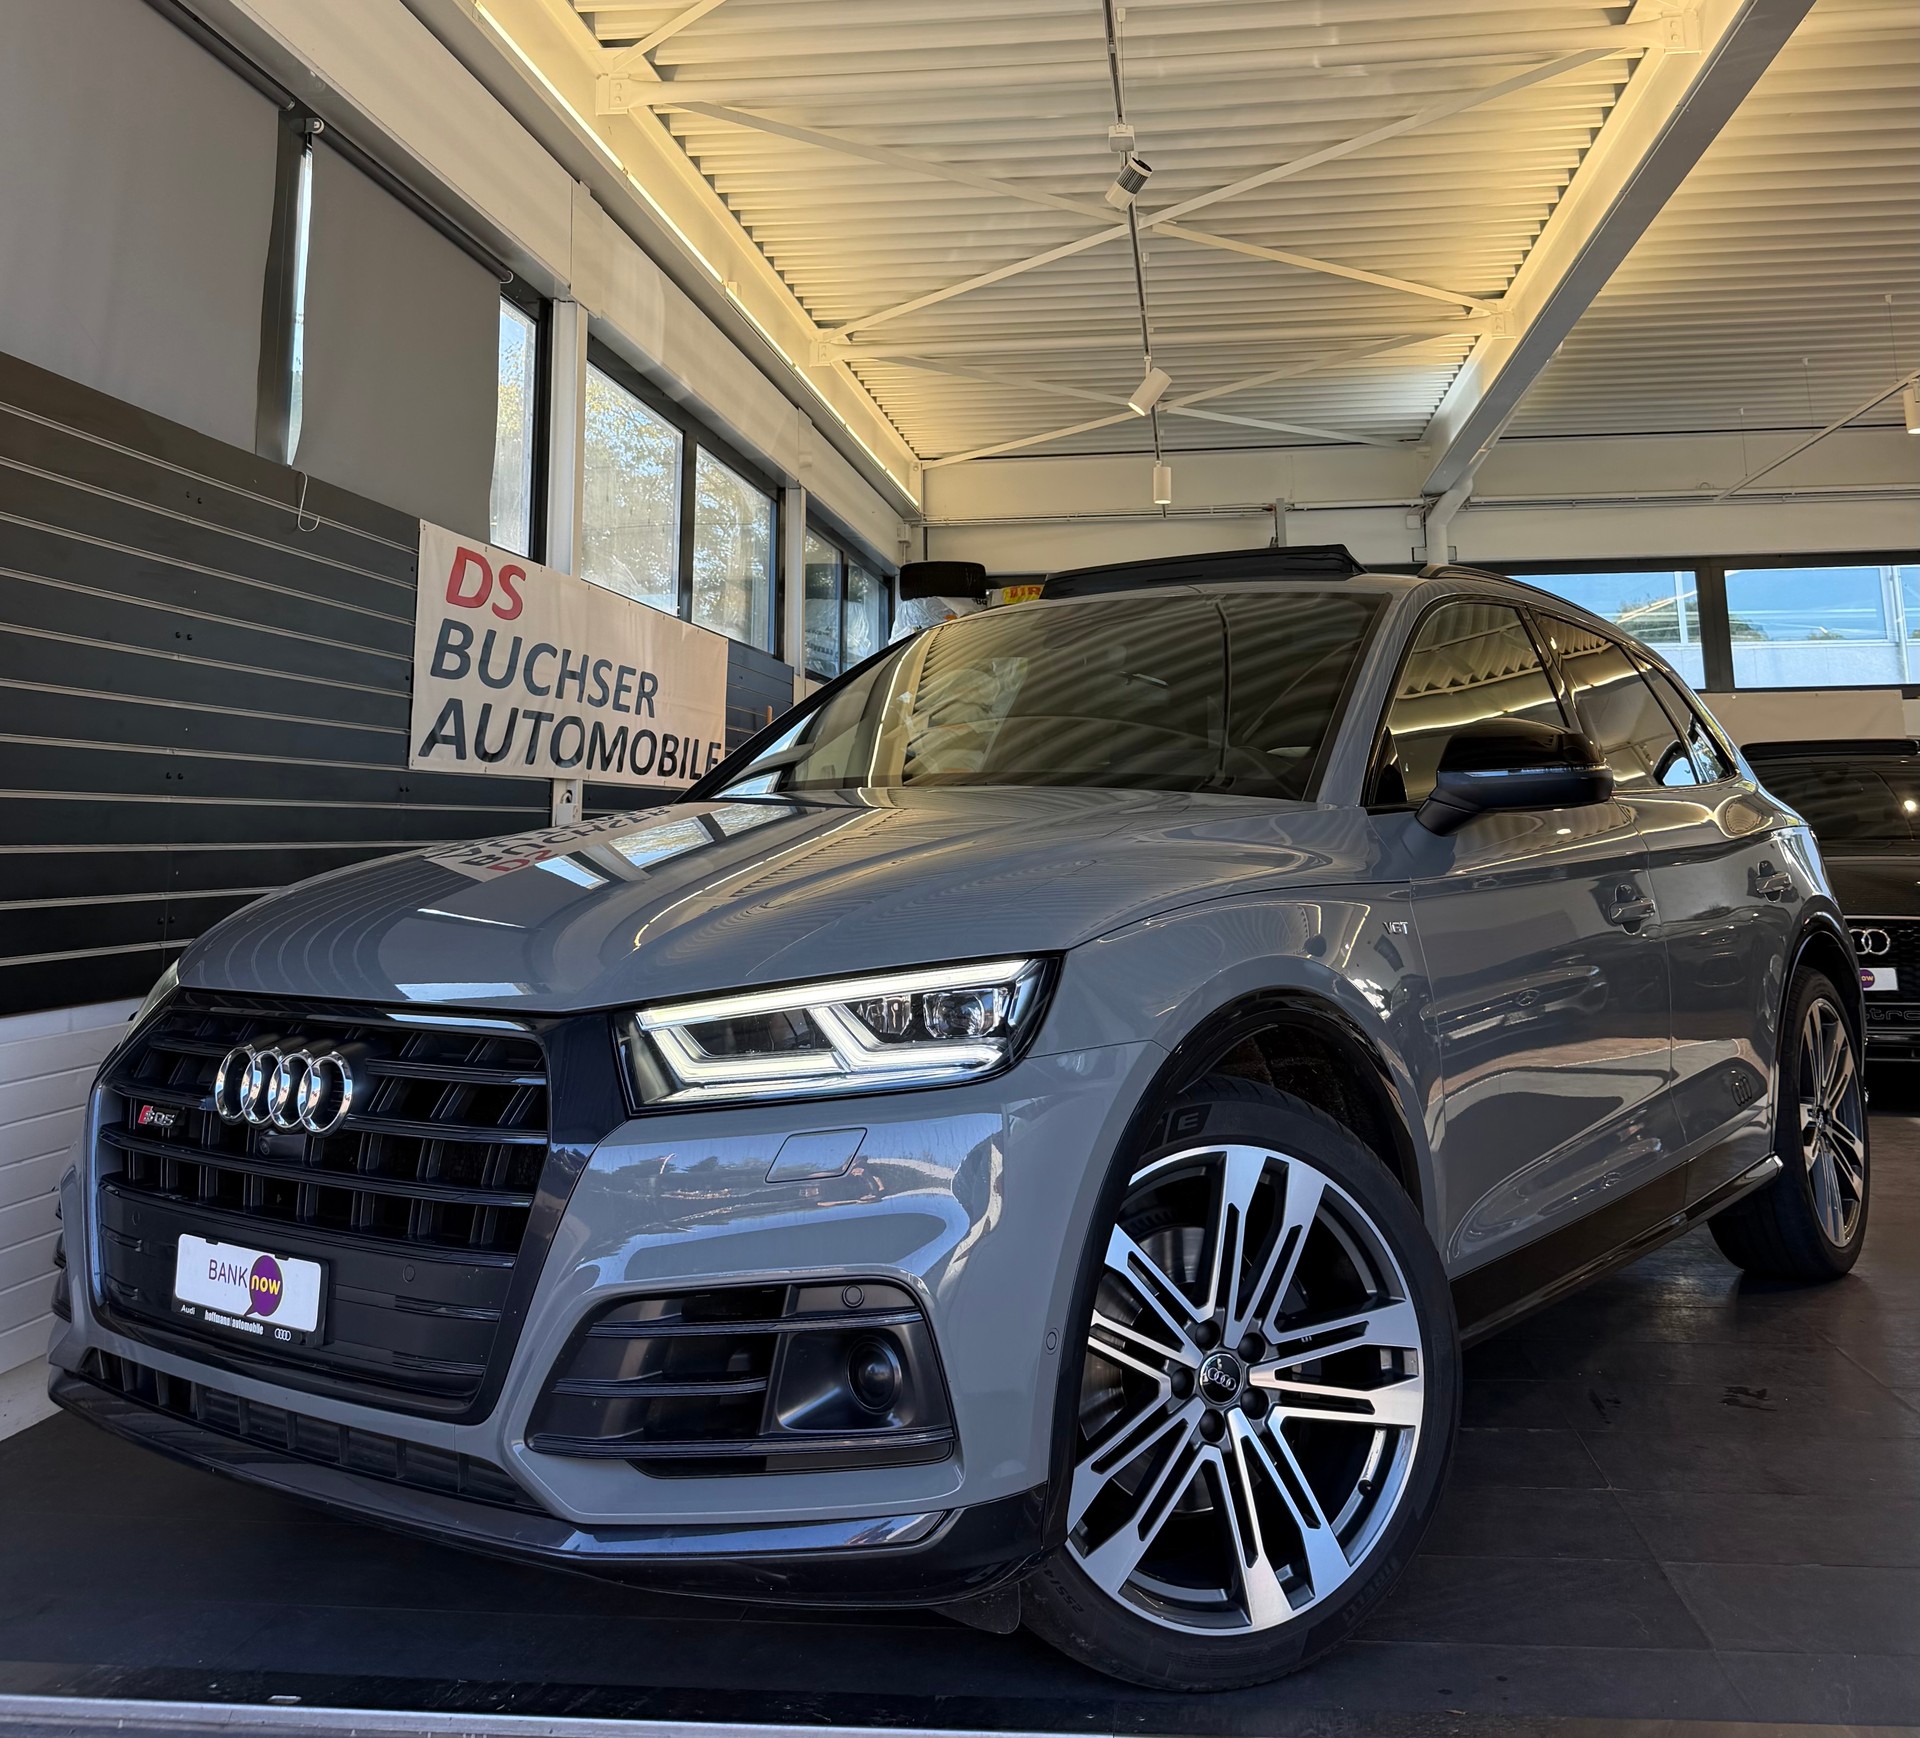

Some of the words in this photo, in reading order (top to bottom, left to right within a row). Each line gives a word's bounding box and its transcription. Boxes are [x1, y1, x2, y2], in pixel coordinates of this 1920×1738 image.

[446, 546, 526, 620] DS
[430, 618, 659, 718] BUCHSER
[208, 1259, 248, 1288] BANK
[251, 1275, 281, 1295] now
[180, 1304, 195, 1315] Audi
